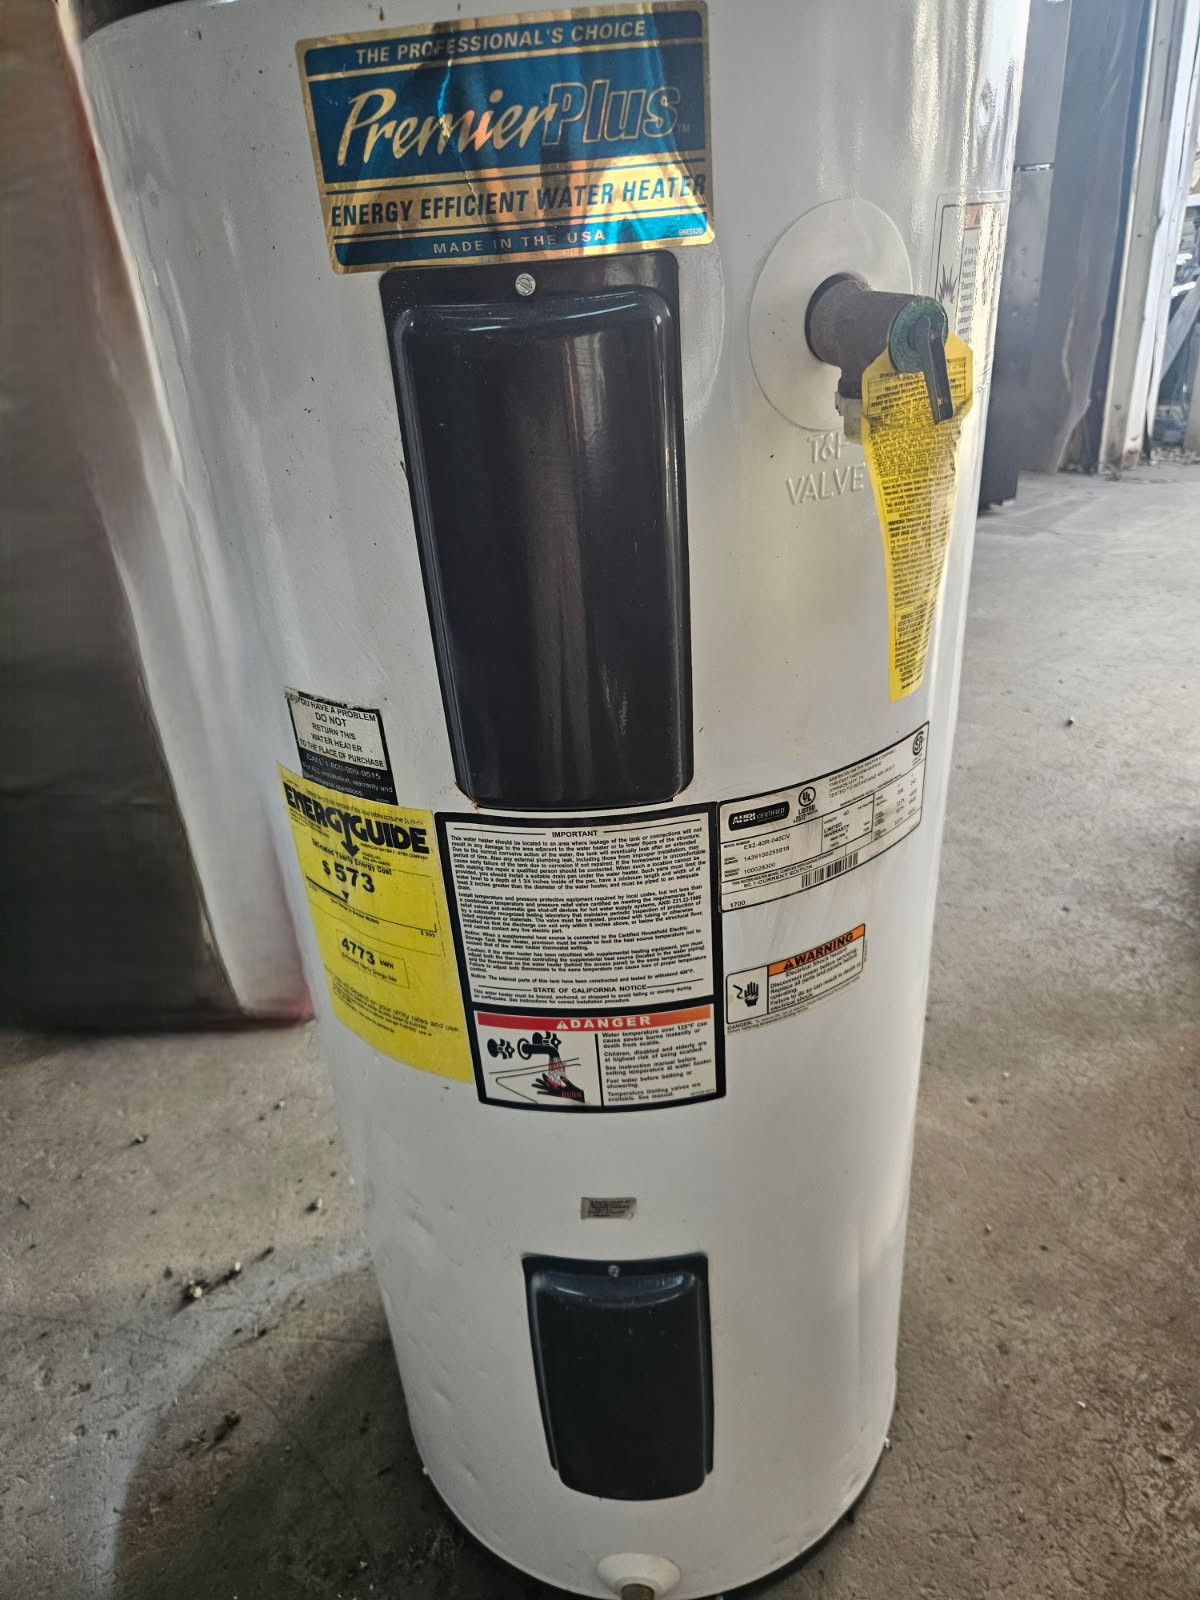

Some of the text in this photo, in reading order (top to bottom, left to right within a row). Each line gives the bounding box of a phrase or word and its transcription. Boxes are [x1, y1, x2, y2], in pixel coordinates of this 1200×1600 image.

[356, 20, 647, 66] THE PROFESSIONAL'S CHOICE
[331, 174, 706, 227] ENERGY EFFICIENT WATER HEATER
[433, 230, 606, 254] MADE IN THE USA
[785, 461, 866, 505] VALVE
[312, 700, 330, 713] HAVE
[331, 706, 336, 714] A
[338, 708, 377, 722] PROBLEM
[315, 712, 347, 727] DO NOT
[312, 722, 356, 741] RETURN THIS
[311, 733, 363, 752] WATER HEATER
[308, 741, 318, 751] THE
[319, 746, 337, 758] PLACE
[338, 752, 347, 760] OF
[348, 754, 384, 767] PURCHASE
[756, 808, 786, 820] CERTIFIED
[552, 830, 598, 838] IMPORTANT
[650, 830, 681, 839] connections
[824, 822, 842, 834] LIMITED
[354, 858, 375, 872] Energy
[377, 864, 393, 876] Cost
[730, 900, 746, 909] 1700
[342, 938, 375, 965] 4773
[794, 932, 854, 966] WARNING
[786, 964, 811, 977] Electrical
[812, 956, 829, 967] Shock
[770, 974, 802, 989] Disconnect
[802, 968, 819, 978] power
[820, 960, 836, 970] before
[571, 986, 617, 994] CALIFORNIA
[619, 984, 647, 992] NOTICE
[770, 984, 793, 994] Replace
[802, 976, 815, 985] parts
[770, 996, 790, 1006] Failure
[824, 976, 837, 985] result
[770, 1000, 796, 1012] electrical
[570, 1016, 652, 1029] DANGER
[622, 1029, 659, 1037] temperature
[666, 1030, 691, 1039] instantly
[634, 1048, 660, 1056] disabled
[676, 1042, 695, 1051] elderly
[660, 1050, 677, 1058] being
[678, 1056, 697, 1064] before
[629, 1066, 665, 1075] temperature
[662, 1071, 684, 1080] bathing
